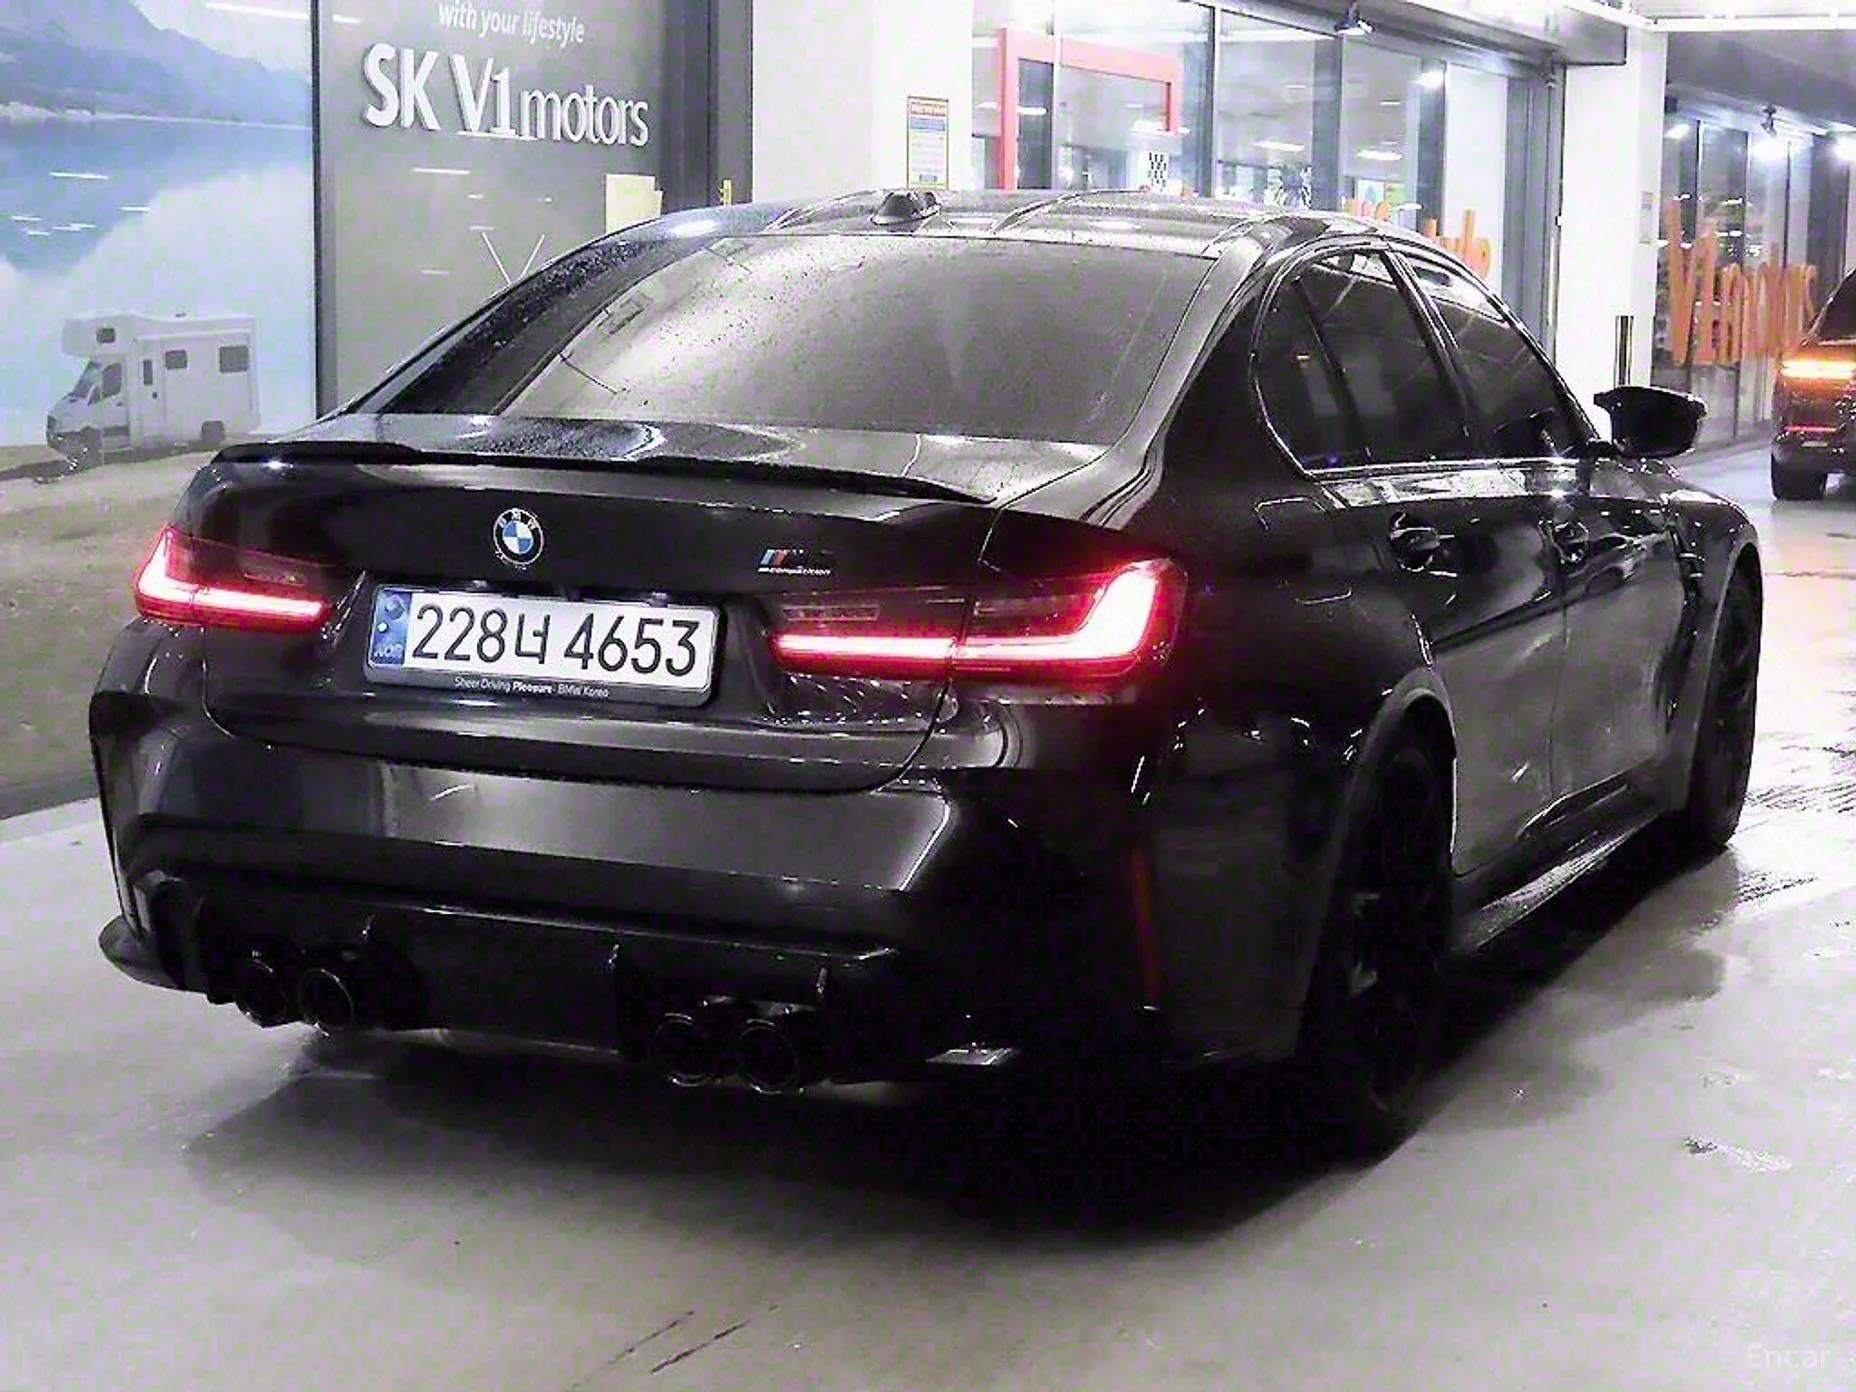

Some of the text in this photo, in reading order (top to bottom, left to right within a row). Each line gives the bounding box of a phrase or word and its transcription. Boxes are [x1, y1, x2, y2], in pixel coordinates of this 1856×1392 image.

[438, 0, 585, 48] with your lifestyle
[363, 43, 650, 146] SK V1 motors
[412, 603, 700, 677] 228너 4653
